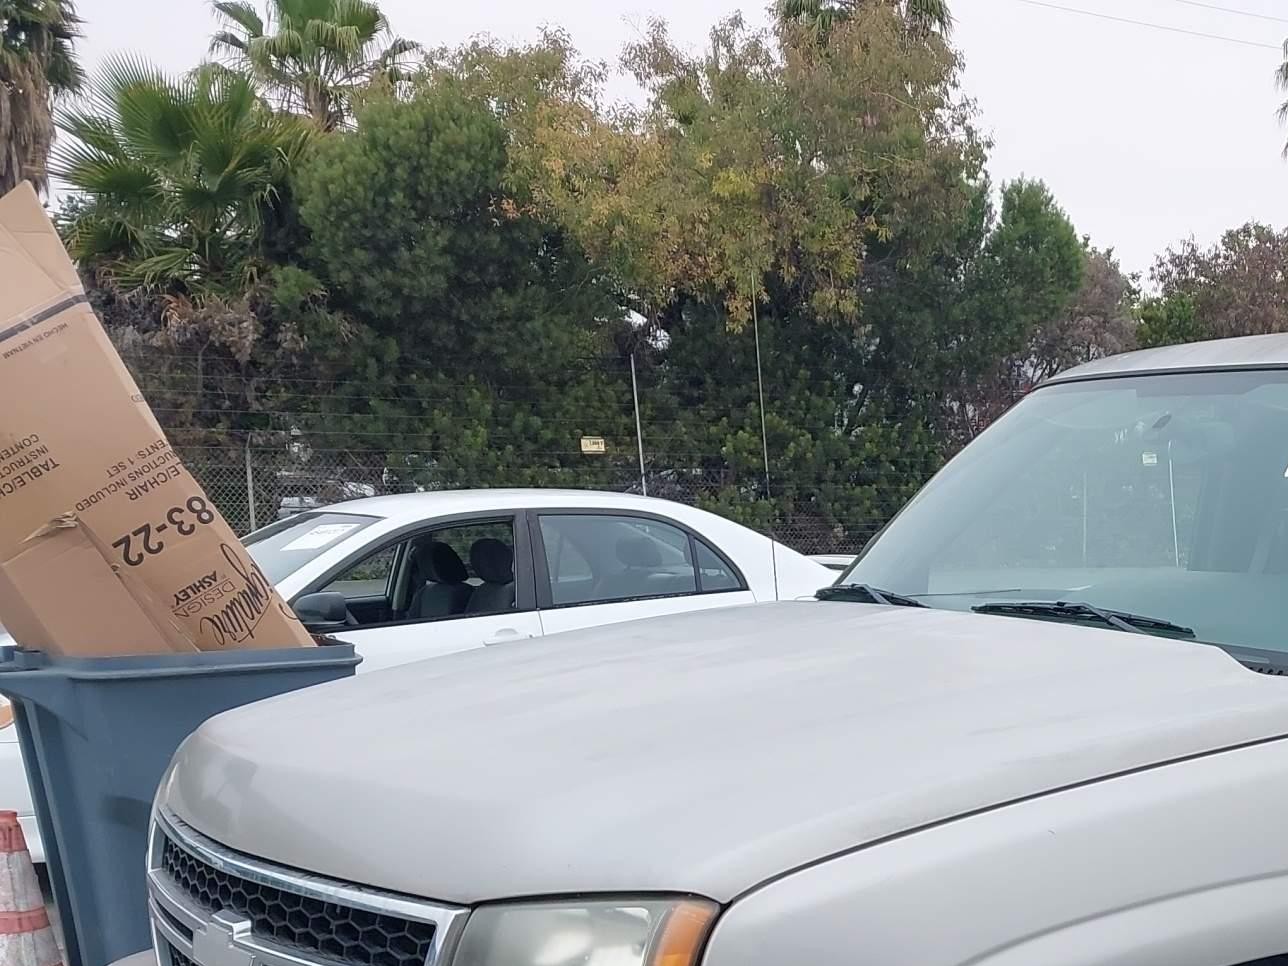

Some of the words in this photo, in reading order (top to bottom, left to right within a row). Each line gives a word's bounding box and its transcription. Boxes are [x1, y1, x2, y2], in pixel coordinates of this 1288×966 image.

[105, 461, 128, 478] SET
[75, 478, 128, 512] INCLUDED
[111, 496, 215, 567] 83-22
[173, 570, 217, 606] ASHLEY
[174, 580, 236, 618] DESIGN
